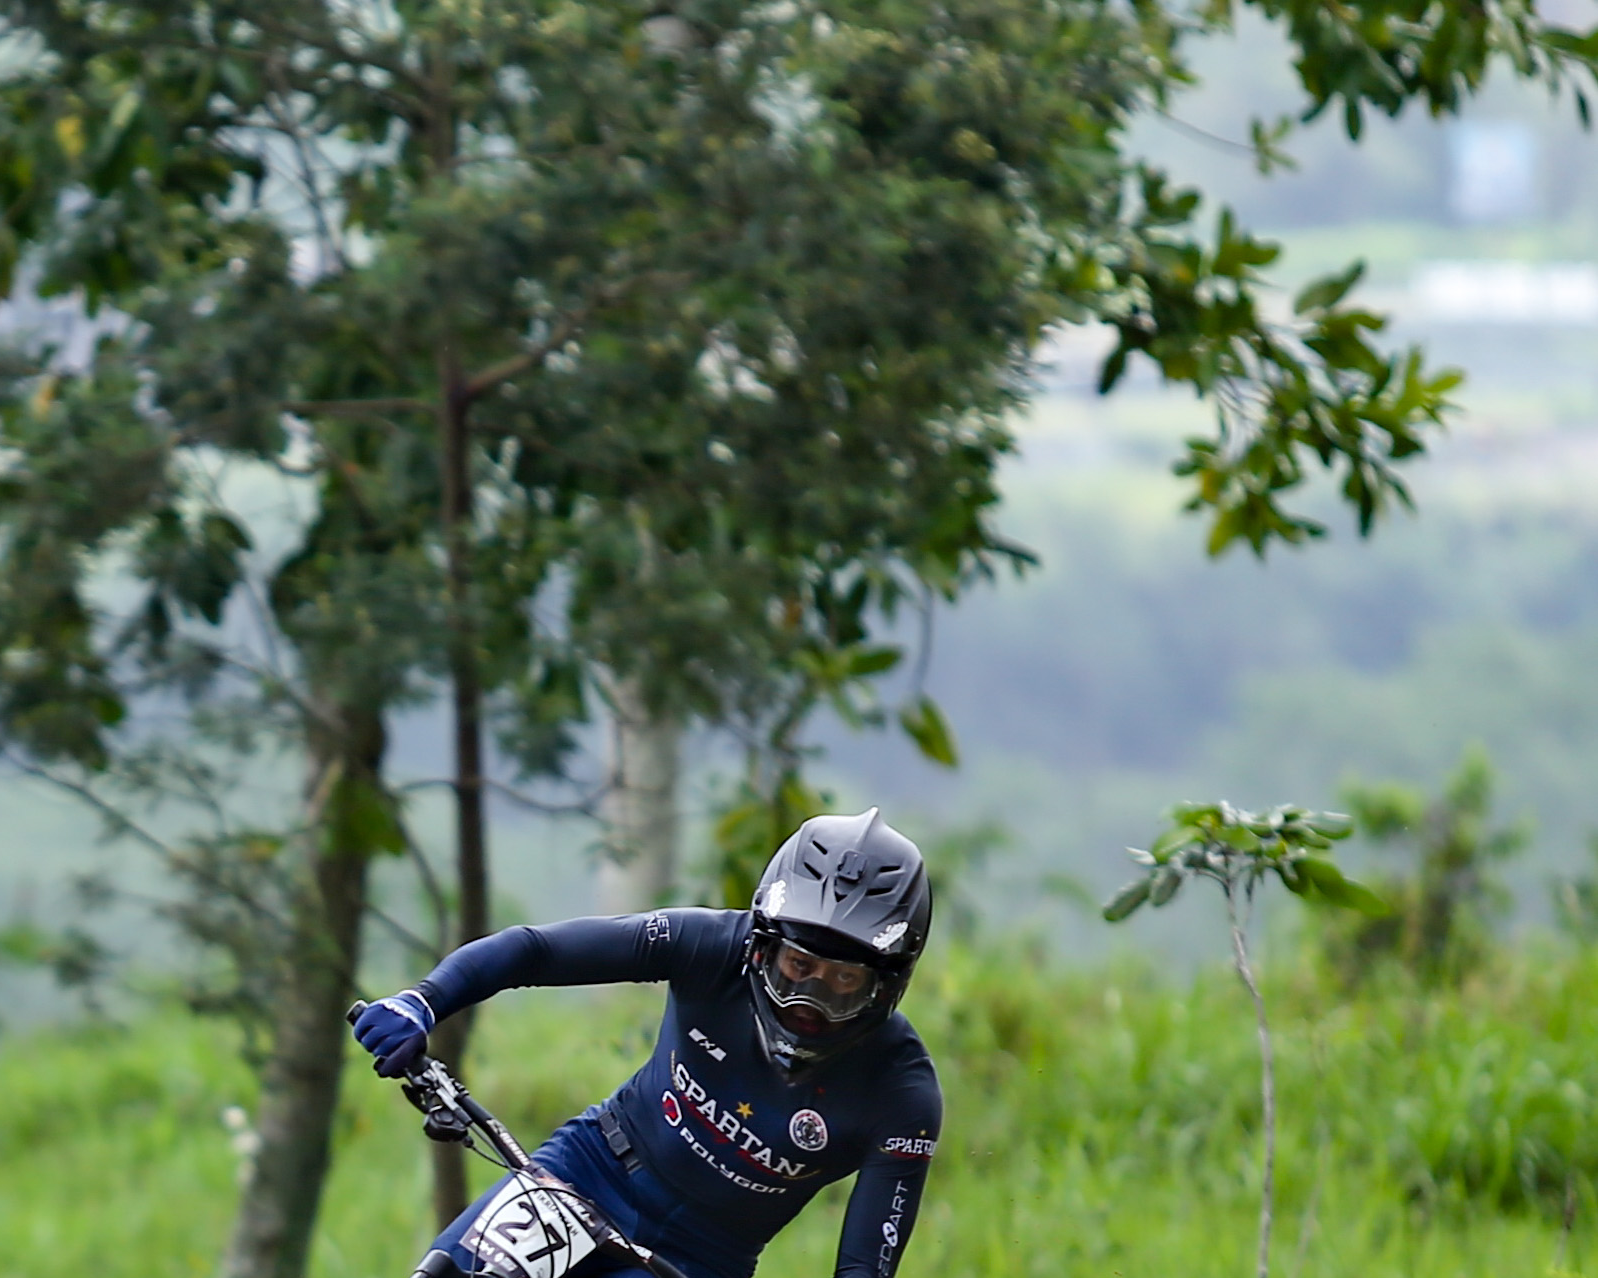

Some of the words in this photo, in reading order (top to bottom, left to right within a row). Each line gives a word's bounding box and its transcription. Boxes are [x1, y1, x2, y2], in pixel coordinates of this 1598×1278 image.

[675, 1063, 806, 1177] SPARTAN
[679, 1127, 787, 1194] POLYGON
[494, 1200, 569, 1263] 27
[889, 1180, 909, 1230] ART
